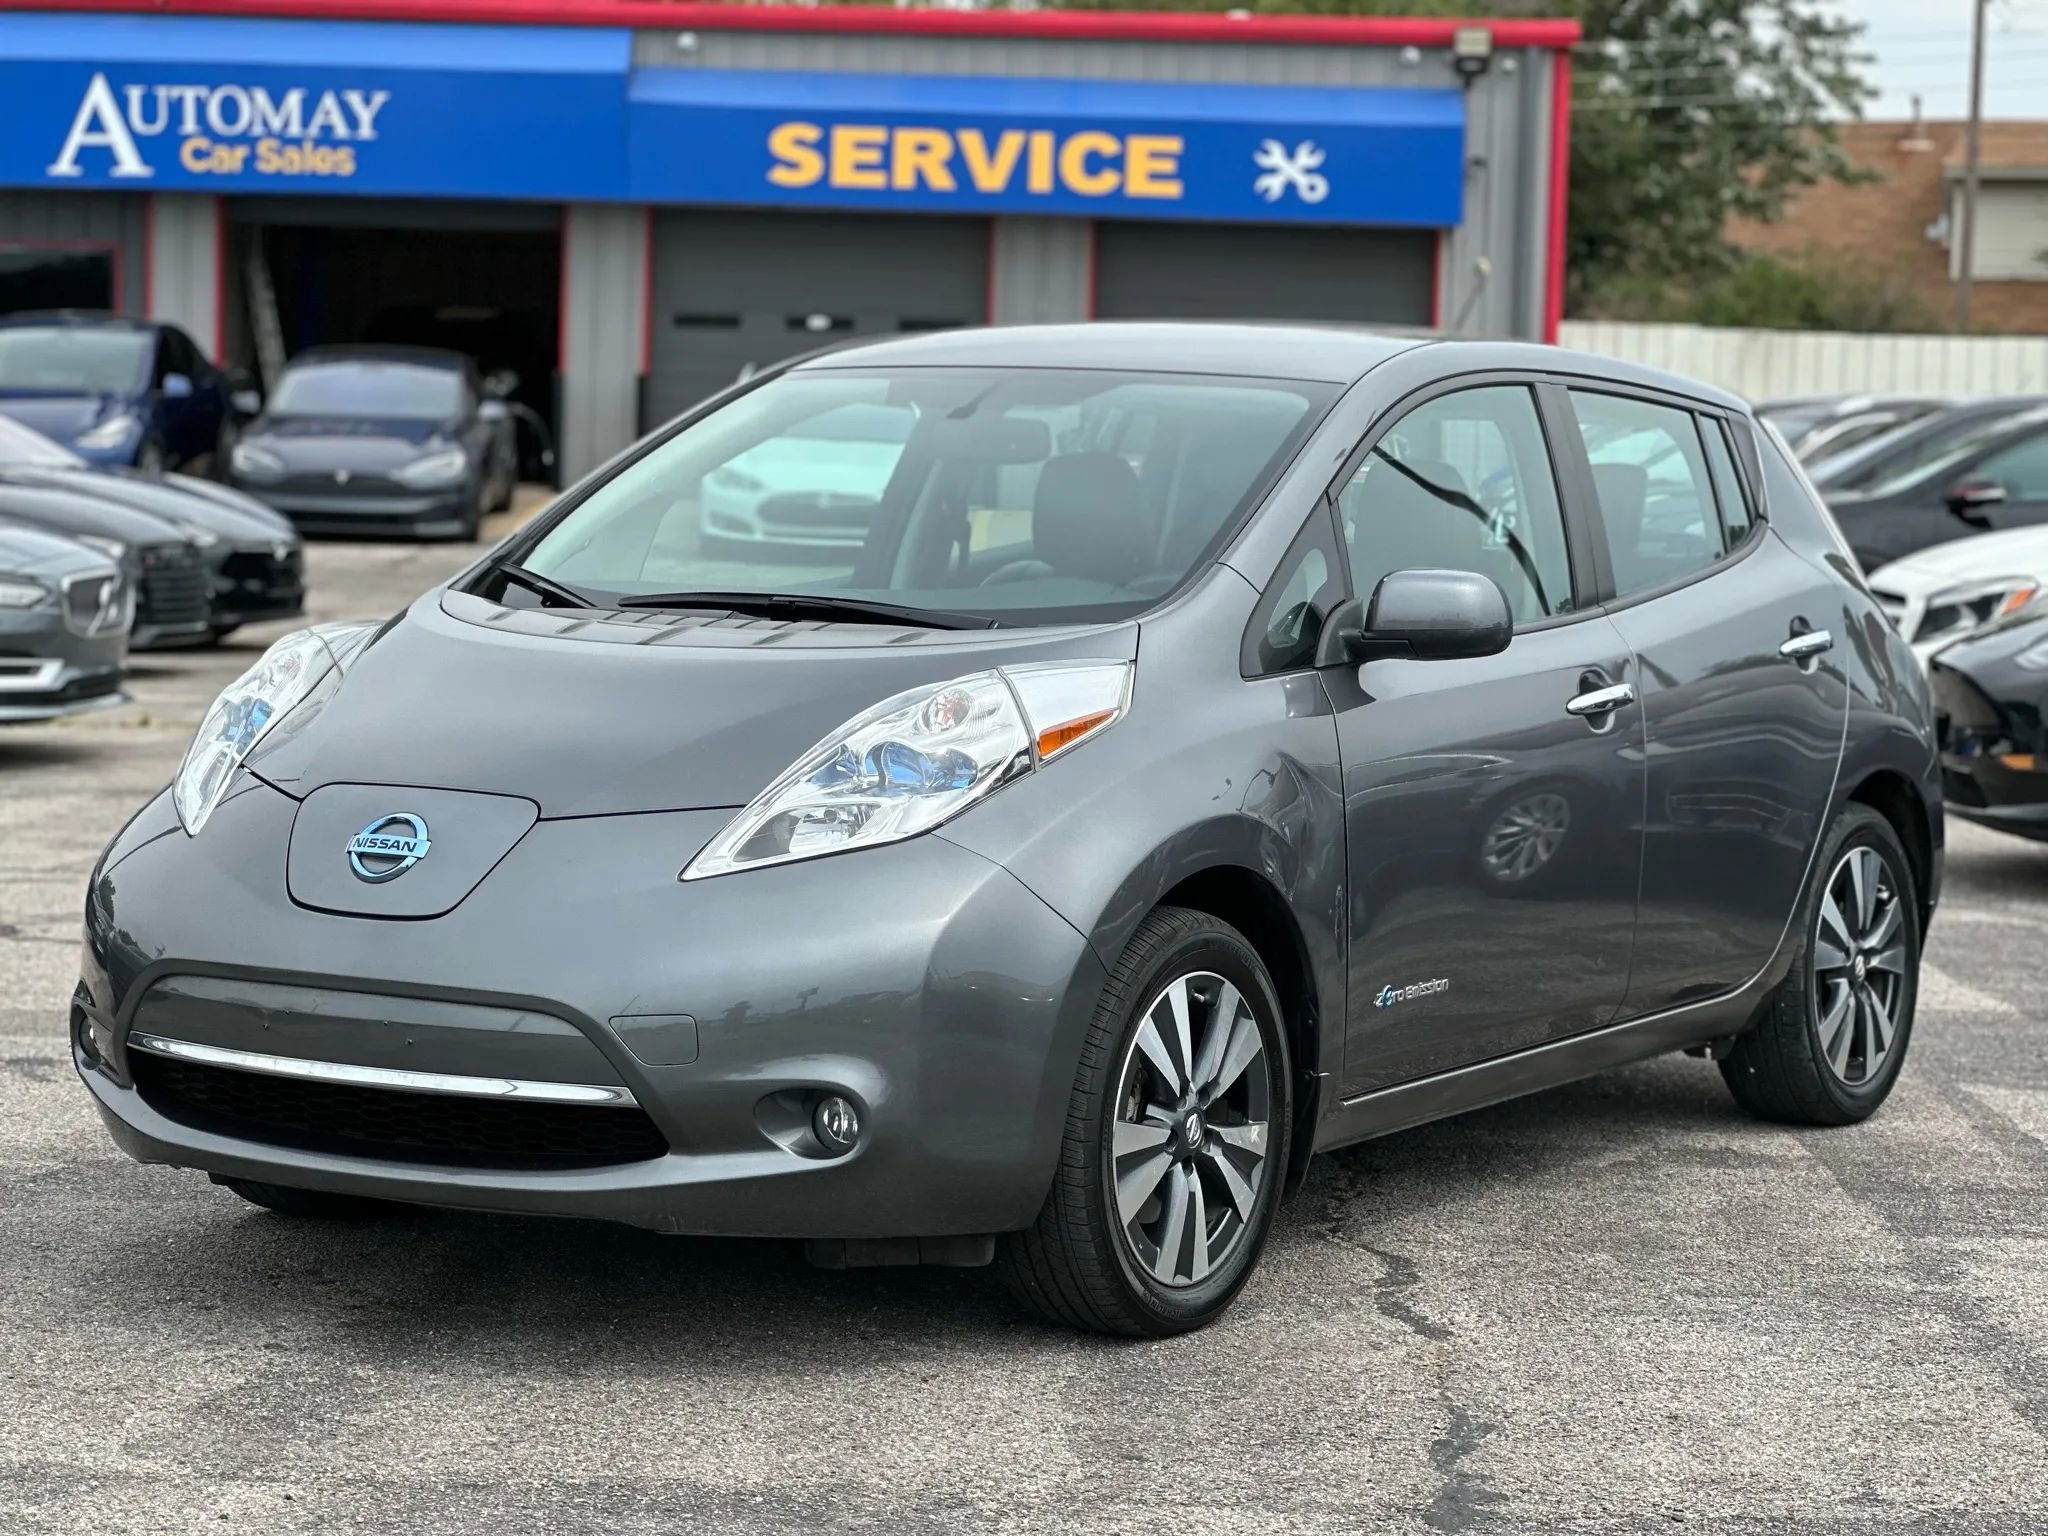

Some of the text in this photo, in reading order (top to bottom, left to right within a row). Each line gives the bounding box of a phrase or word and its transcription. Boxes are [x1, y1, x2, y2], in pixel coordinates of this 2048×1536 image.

[46, 71, 391, 178] AUTOMAY
[179, 135, 357, 177] Car Sales
[766, 121, 1185, 200] SERVICE
[352, 837, 418, 853] NISSAN
[1405, 978, 1449, 1000] Emission
